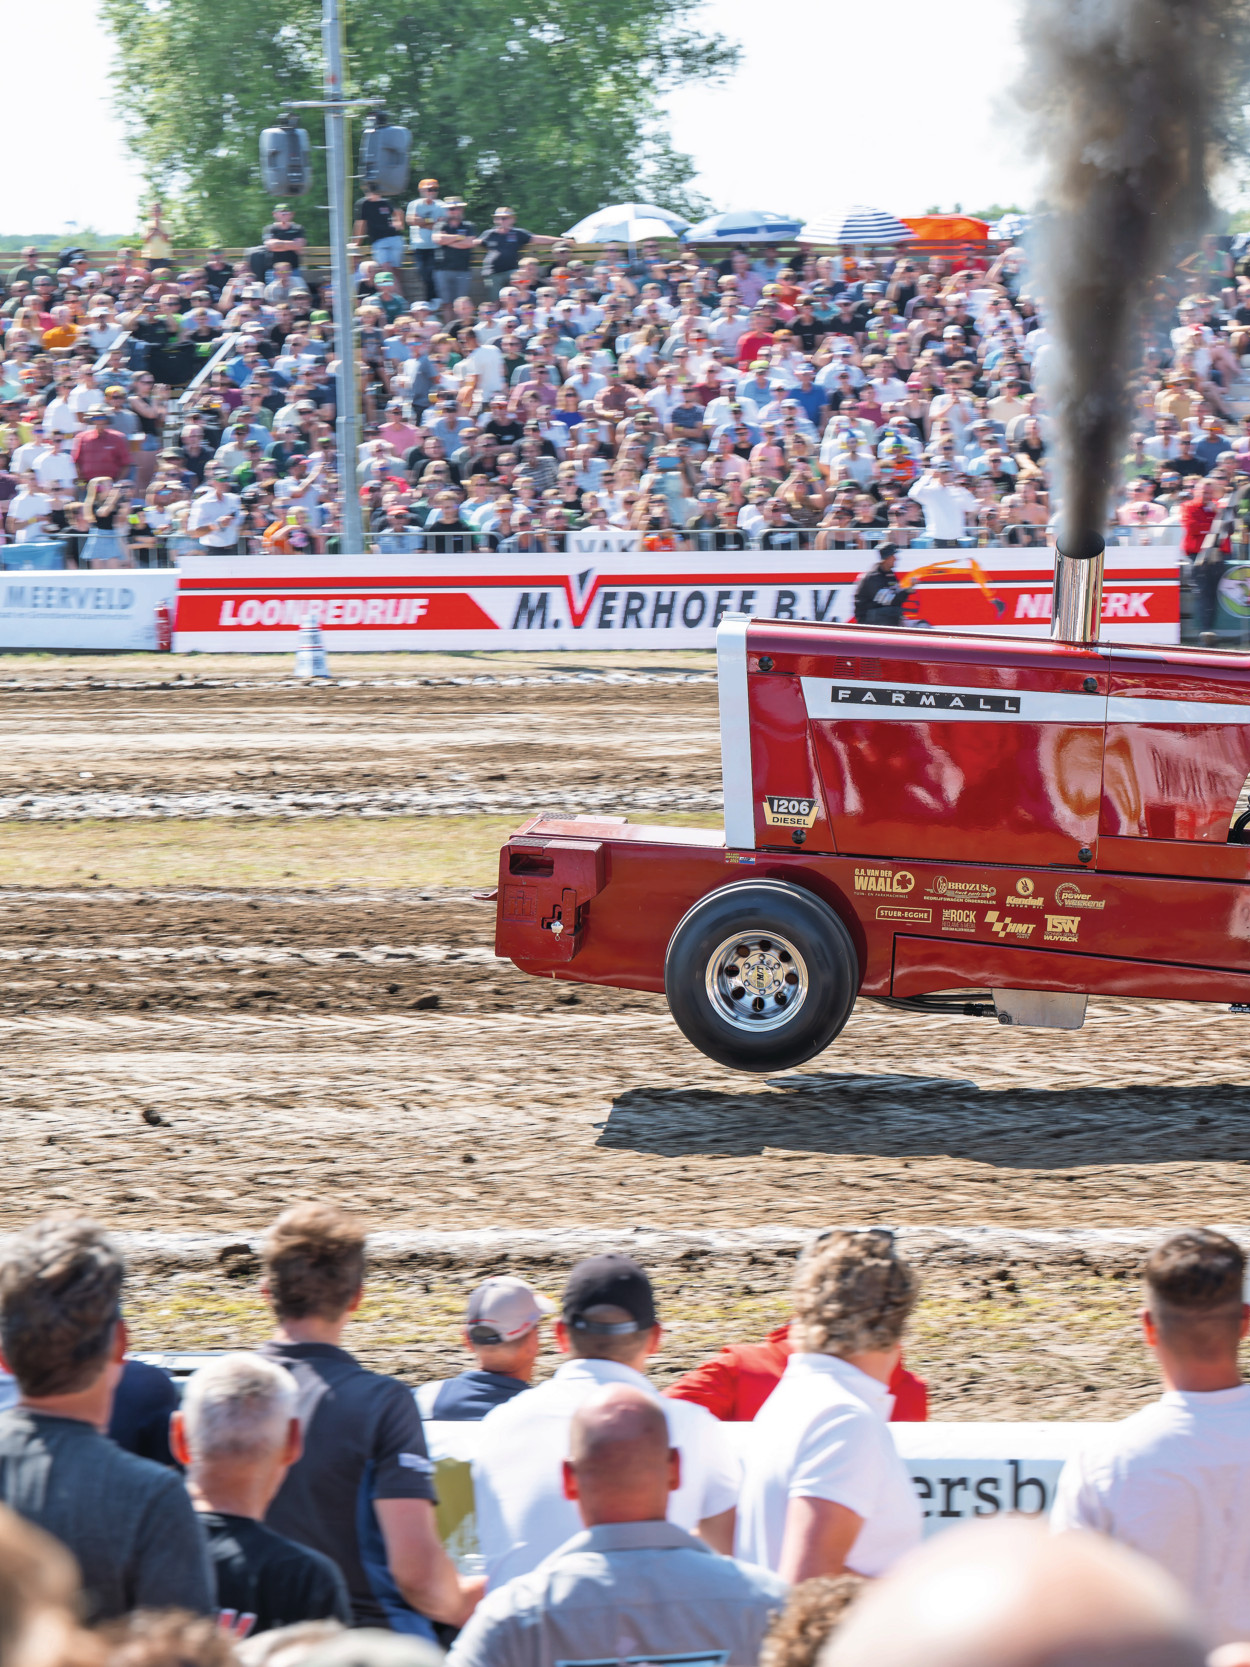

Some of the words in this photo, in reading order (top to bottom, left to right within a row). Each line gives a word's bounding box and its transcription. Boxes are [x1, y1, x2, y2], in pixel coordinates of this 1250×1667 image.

[219, 598, 429, 626] LOONBEDRIJF
[838, 690, 1017, 712] FARMALL
[773, 799, 809, 815] 1206
[772, 816, 809, 826] DIESEL
[867, 869, 879, 877] VAN
[880, 870, 892, 878] DER
[854, 876, 893, 892] WAAL
[948, 882, 988, 891] BROZUS
[1006, 896, 1044, 906] Kendall
[880, 910, 928, 919] STUER-EGGHE
[942, 909, 950, 920] THE
[950, 910, 976, 923] ROCK
[1006, 923, 1036, 934] HMT
